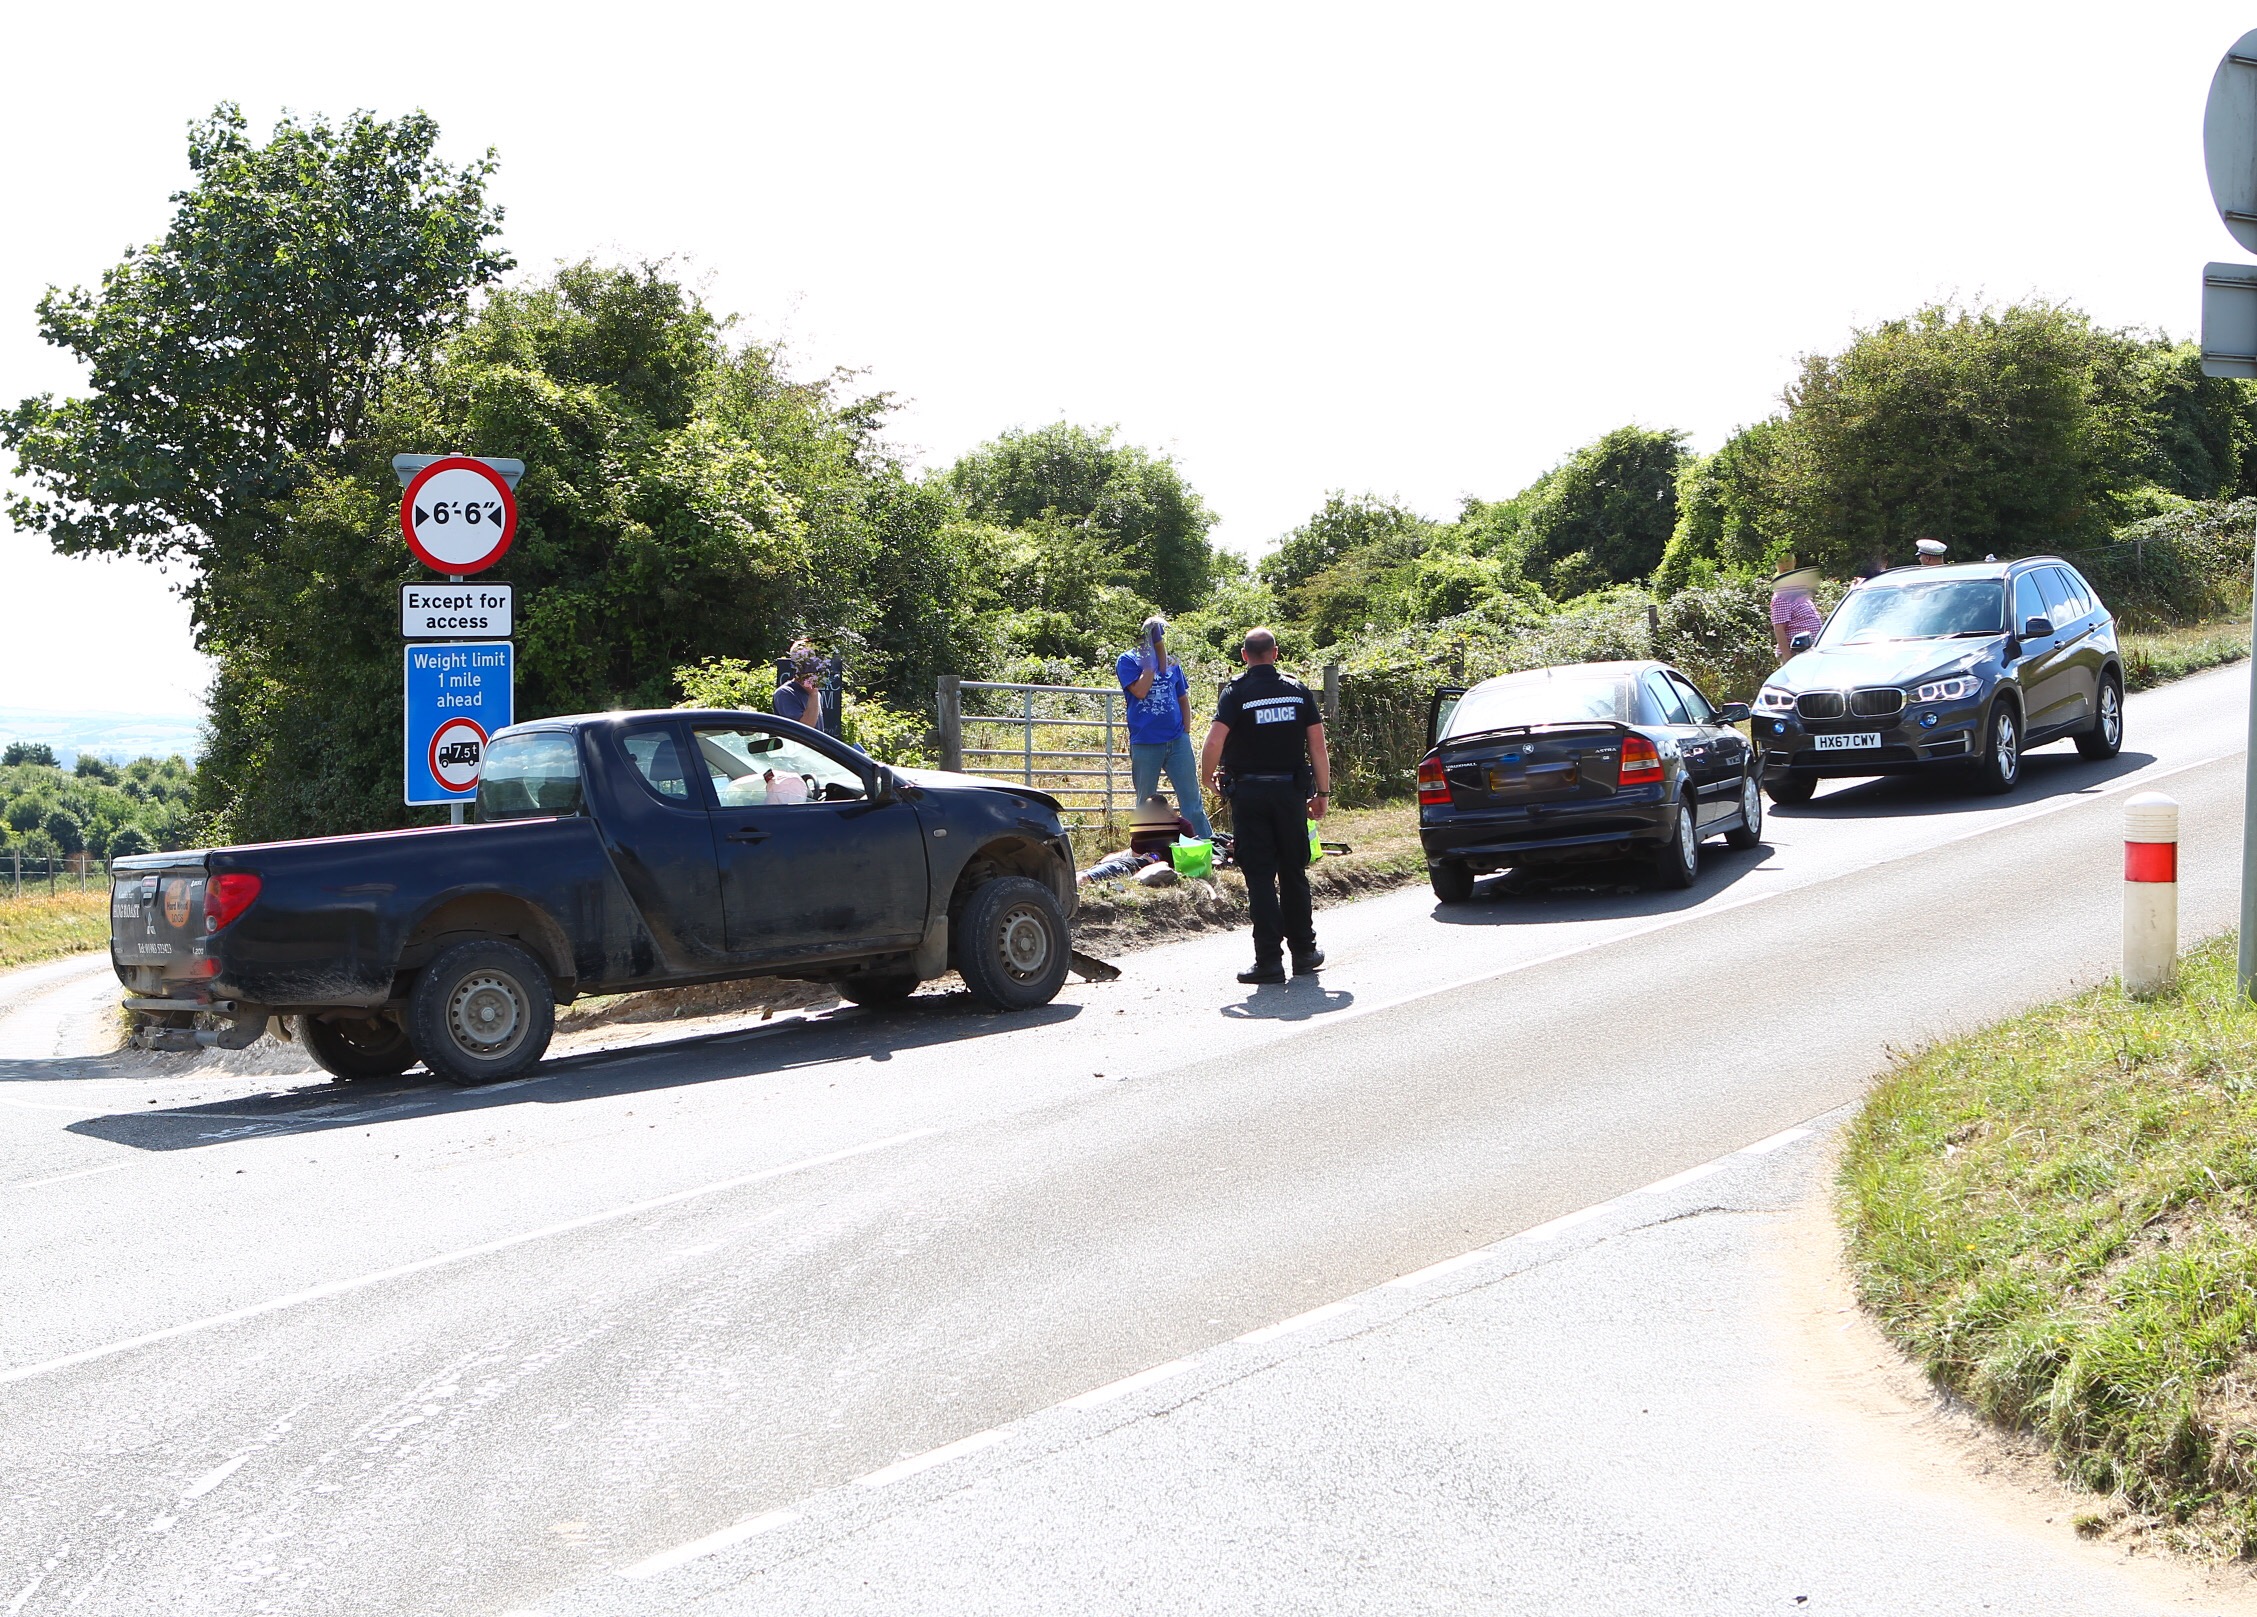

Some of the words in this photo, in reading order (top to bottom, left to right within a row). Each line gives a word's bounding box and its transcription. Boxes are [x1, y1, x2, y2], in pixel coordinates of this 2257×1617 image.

[409, 593, 473, 611] Except
[480, 593, 506, 608] for
[426, 616, 488, 628] access
[414, 653, 467, 671] Weight
[472, 652, 505, 667] limit
[438, 673, 444, 687] 1
[450, 672, 481, 687] mile
[437, 691, 482, 707] ahead
[1256, 706, 1295, 724] POLICE
[1820, 736, 1849, 748] HX67
[1853, 734, 1875, 746] CWY
